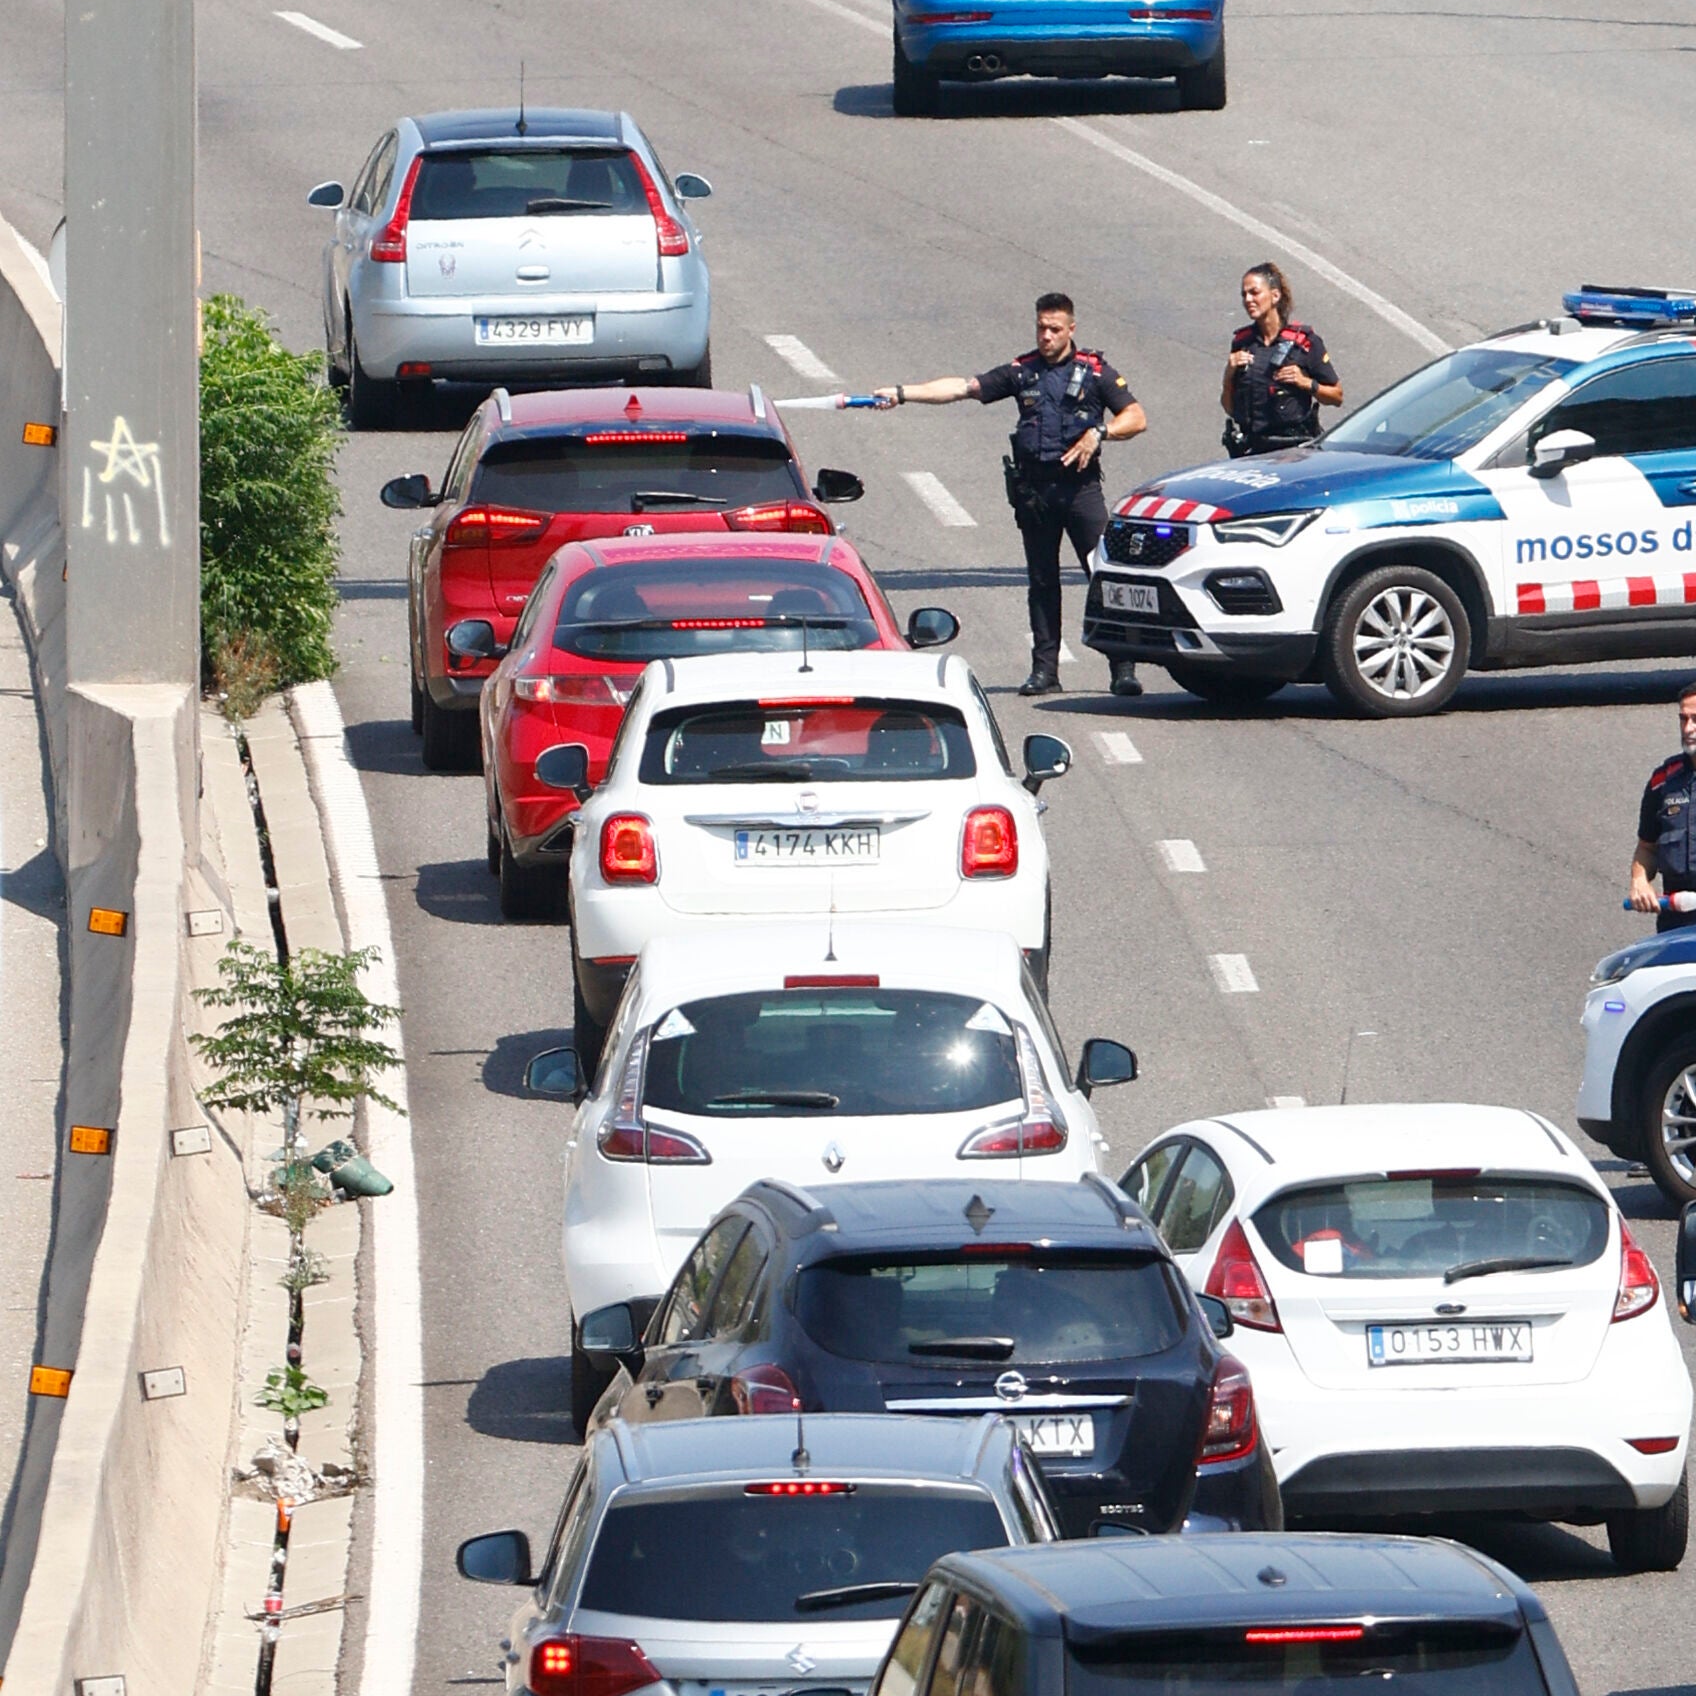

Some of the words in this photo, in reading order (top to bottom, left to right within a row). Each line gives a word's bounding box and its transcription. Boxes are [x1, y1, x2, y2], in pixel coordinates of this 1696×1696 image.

[492, 320, 542, 339] 4329
[547, 319, 584, 337] FVY
[1516, 521, 1659, 564] mossos
[1129, 586, 1154, 609] 1074
[769, 724, 782, 740] N
[754, 833, 817, 856] 4174
[825, 832, 872, 856] KKH
[1391, 1327, 1461, 1354] 0153
[1472, 1326, 1523, 1352] HWX
[1030, 1418, 1085, 1446] KTX
